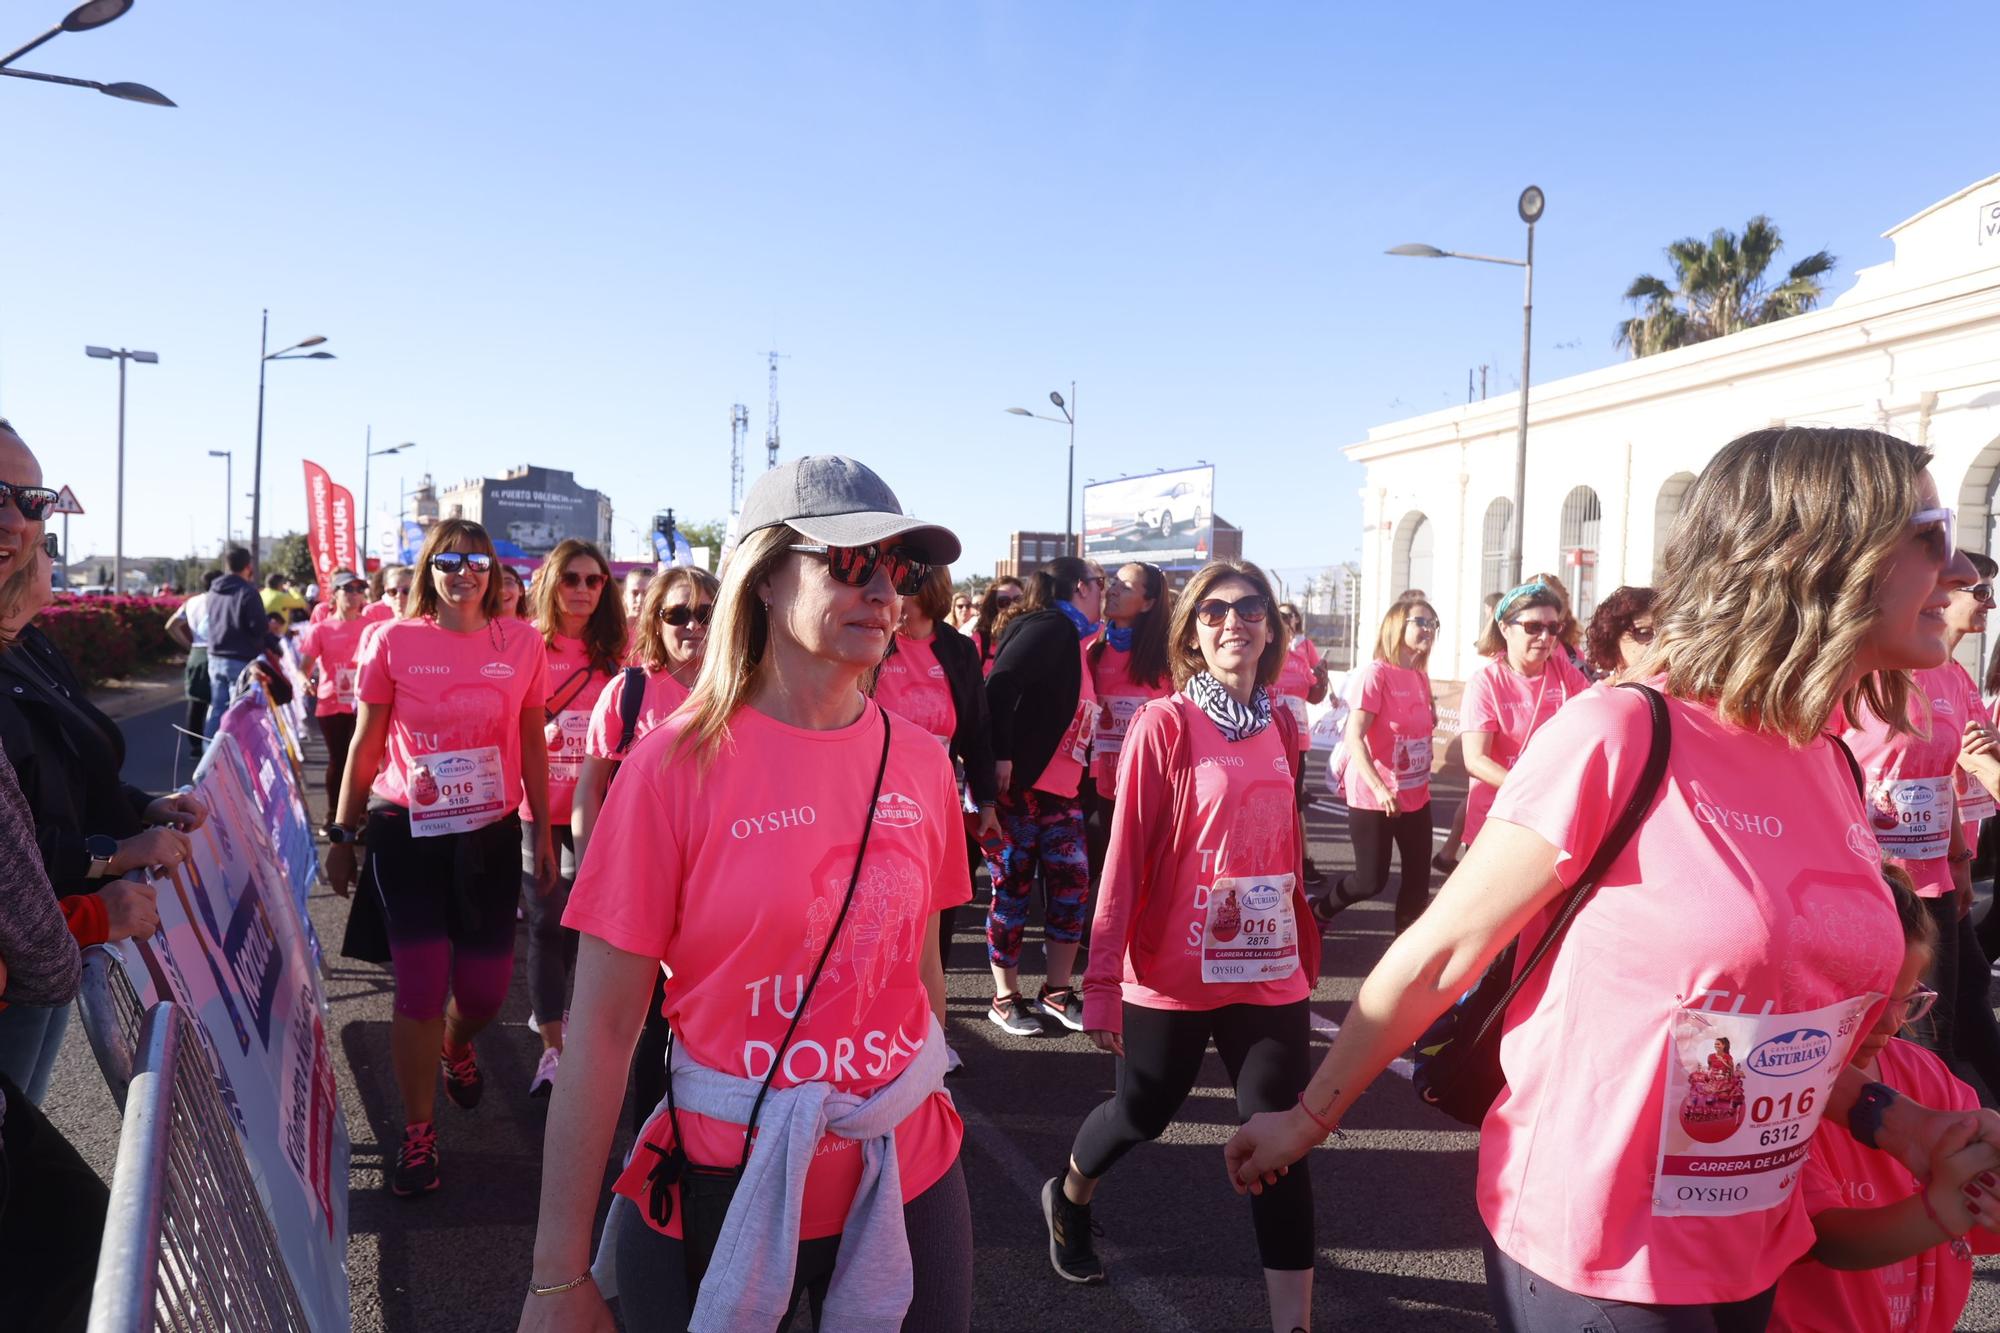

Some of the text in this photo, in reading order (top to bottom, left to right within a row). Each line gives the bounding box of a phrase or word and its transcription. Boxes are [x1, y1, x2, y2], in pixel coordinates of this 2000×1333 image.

[408, 665, 450, 675] OYSHO
[548, 663, 570, 671] SHO
[411, 731, 439, 751] TU
[566, 737, 586, 747] 01
[1199, 755, 1244, 767] OYSHO
[438, 763, 474, 774] ASTURIANA
[442, 782, 474, 796] 016
[449, 796, 470, 806] 5185
[731, 805, 816, 839] OYSHO
[1694, 802, 1784, 838] OYSHO
[1902, 810, 1931, 823] 016
[1909, 825, 1927, 833] 1403
[1200, 848, 1229, 875] TU
[1245, 895, 1278, 905] ASTURIANA
[1243, 918, 1277, 933] 016
[1247, 936, 1270, 946] 2876
[1212, 966, 1244, 975] OYSHO
[745, 974, 805, 1019] TU
[743, 1023, 924, 1084] DORSAL
[1754, 1045, 1826, 1069] ASTURIANA
[1750, 1087, 1816, 1123] 016
[1760, 1123, 1800, 1146] 6312
[816, 1144, 830, 1156] LA
[1689, 1160, 1751, 1172] CARRERA
[1754, 1157, 1771, 1169] DE
[1772, 1153, 1786, 1166] LA
[1677, 1185, 1749, 1202] OYSHO
